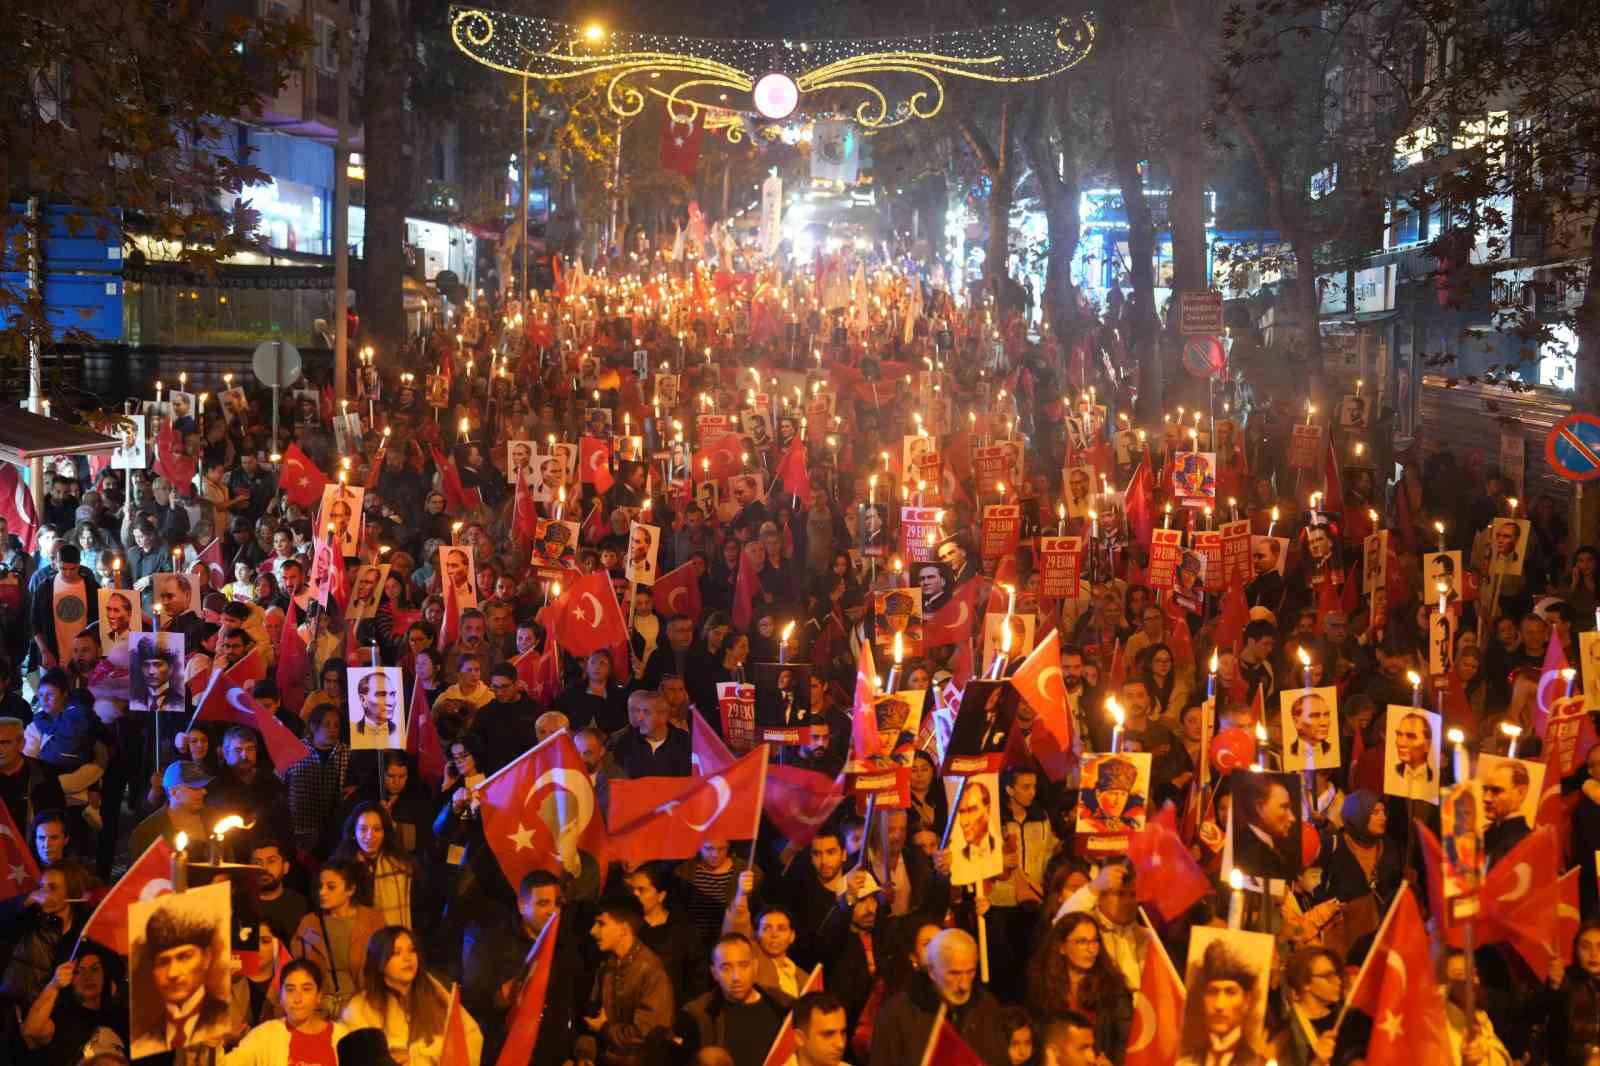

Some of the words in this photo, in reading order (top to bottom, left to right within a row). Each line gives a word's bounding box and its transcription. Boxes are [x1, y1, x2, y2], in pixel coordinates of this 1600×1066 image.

[906, 525, 916, 538] 29
[1046, 555, 1056, 568] 29
[1056, 554, 1076, 568] EKİM
[727, 703, 738, 718] 29
